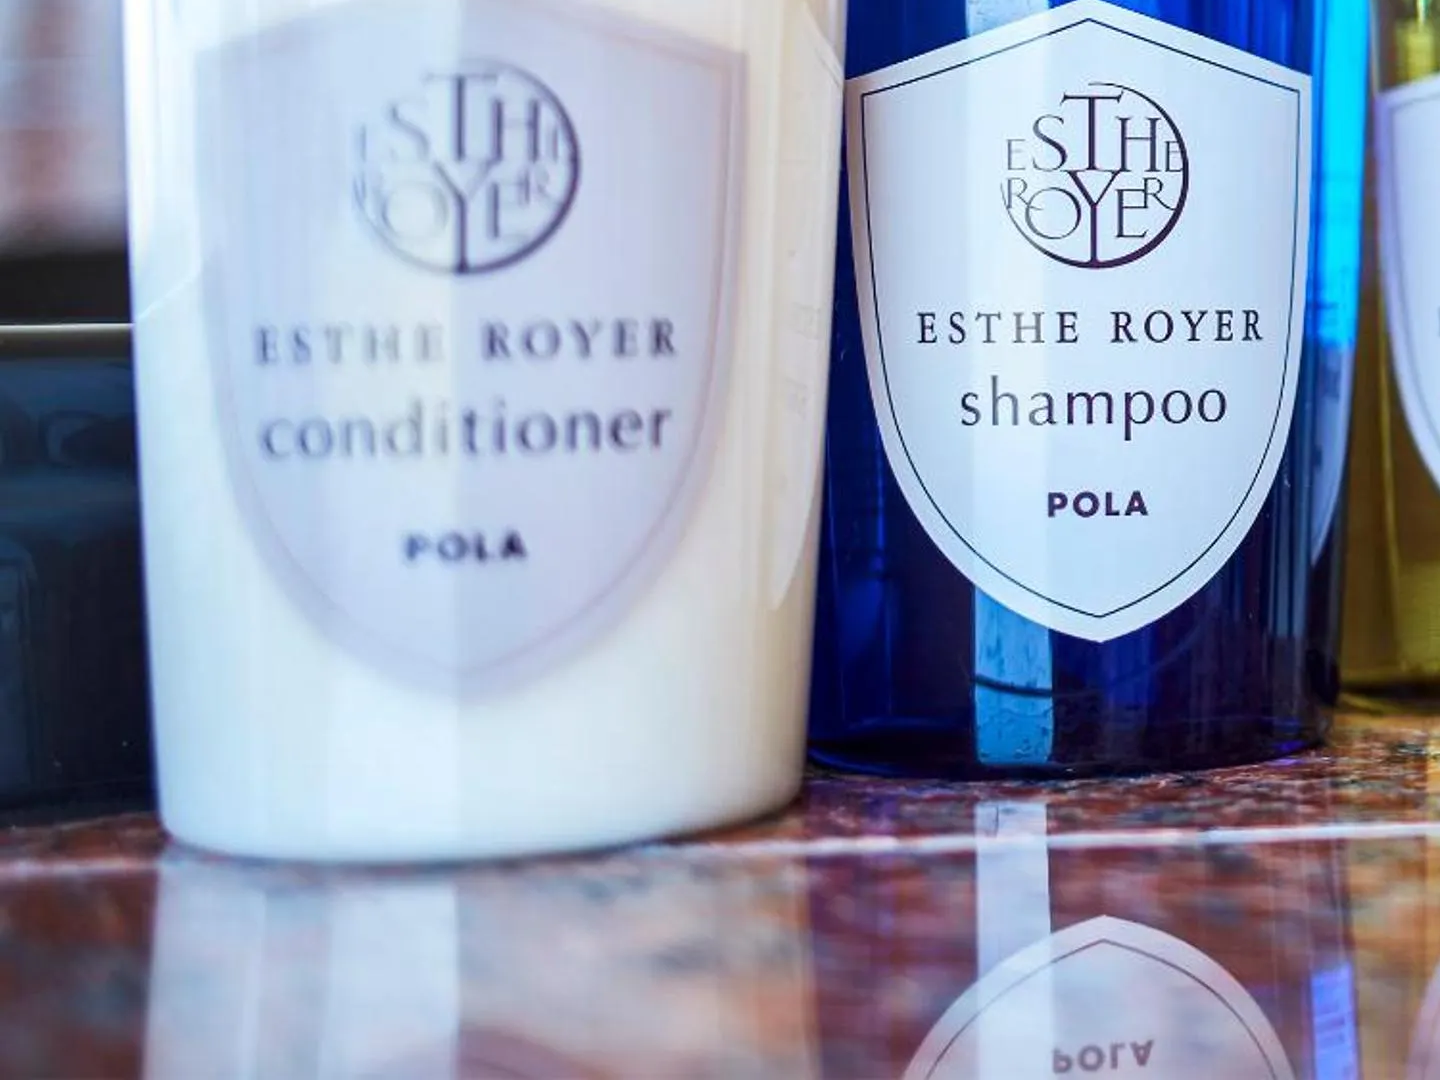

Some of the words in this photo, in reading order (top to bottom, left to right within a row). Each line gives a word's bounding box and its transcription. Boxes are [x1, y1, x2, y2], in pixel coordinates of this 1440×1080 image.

[252, 322, 443, 368] ESTHE
[482, 316, 678, 362] ROYER
[916, 311, 1080, 345] ESTHE
[1110, 309, 1264, 343] ROYER
[257, 398, 672, 462] conditioner
[960, 375, 1228, 442] shampoo
[1046, 490, 1149, 518] POLA
[403, 529, 528, 564] POLA
